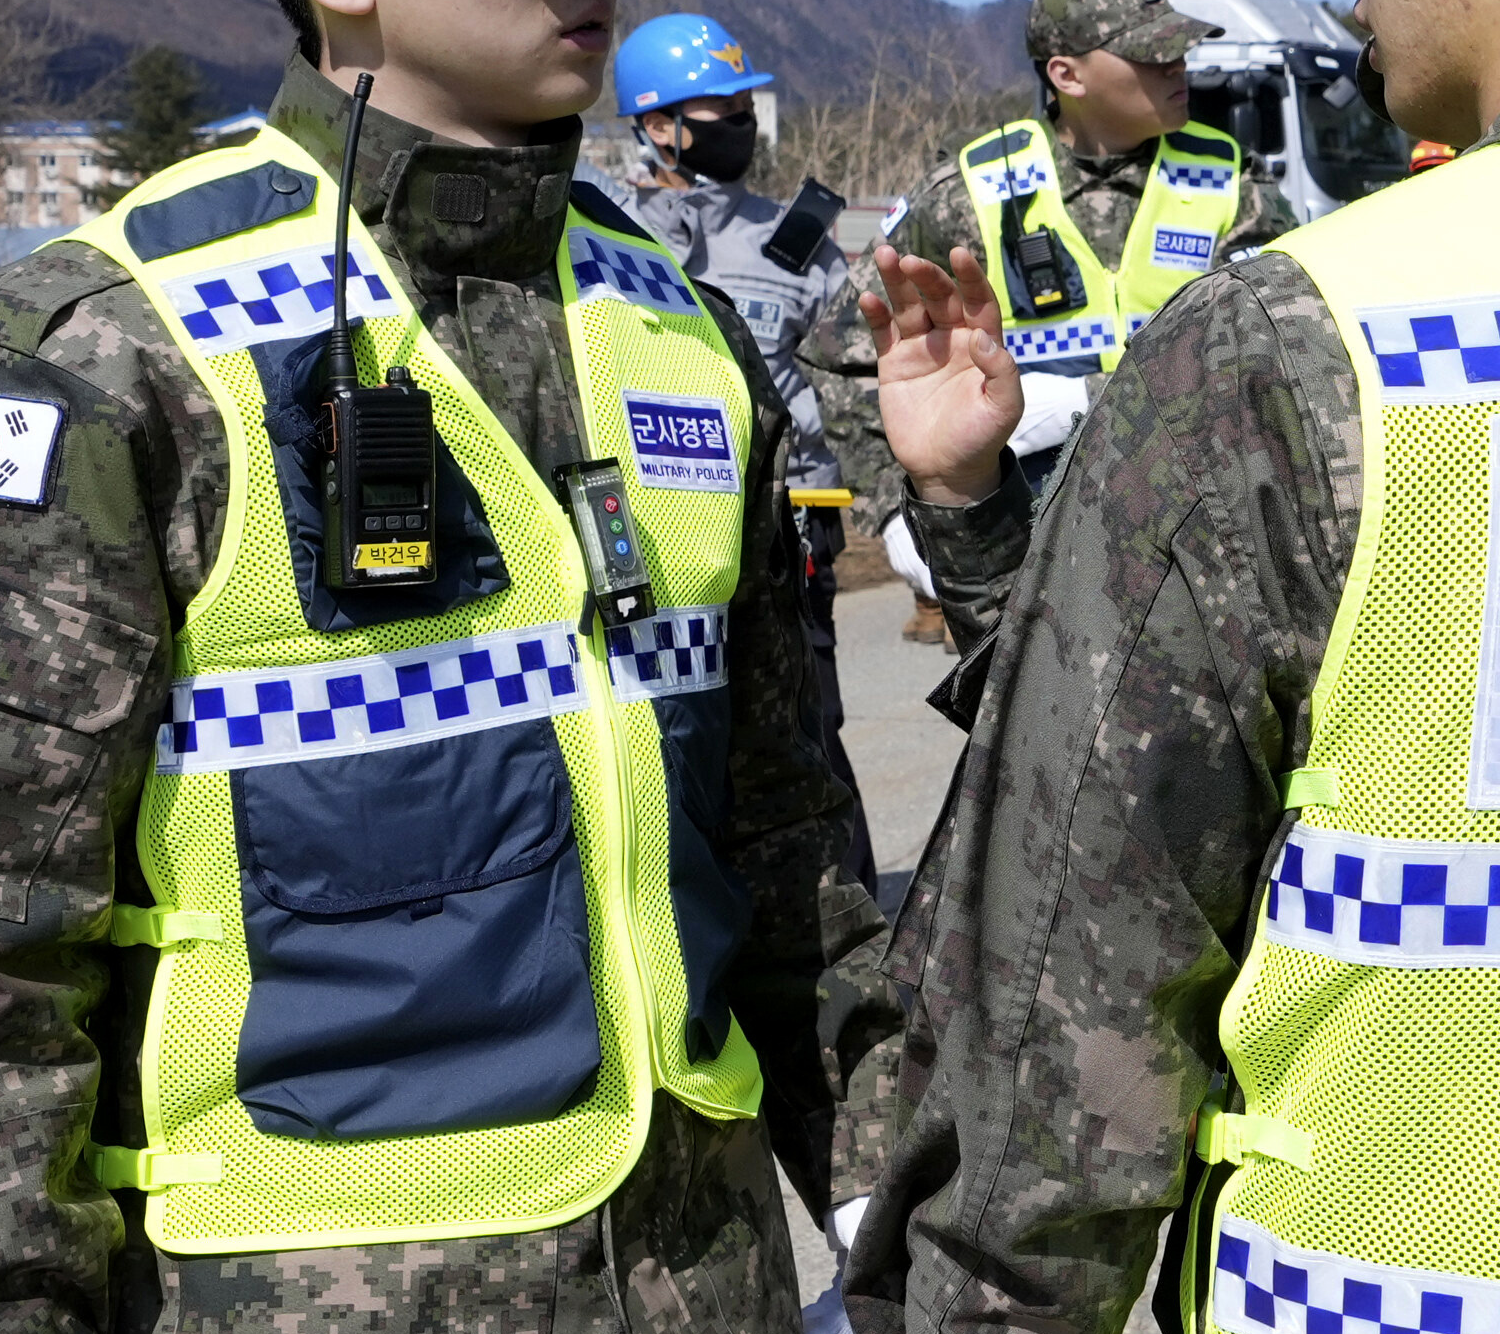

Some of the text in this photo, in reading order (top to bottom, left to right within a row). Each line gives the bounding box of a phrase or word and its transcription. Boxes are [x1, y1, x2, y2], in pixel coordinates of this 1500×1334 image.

[1157, 233, 1210, 255] 군사경찰
[632, 413, 726, 450] 군사경찰
[641, 463, 735, 481] MILITARY POLICE
[370, 545, 422, 564] 박건우
